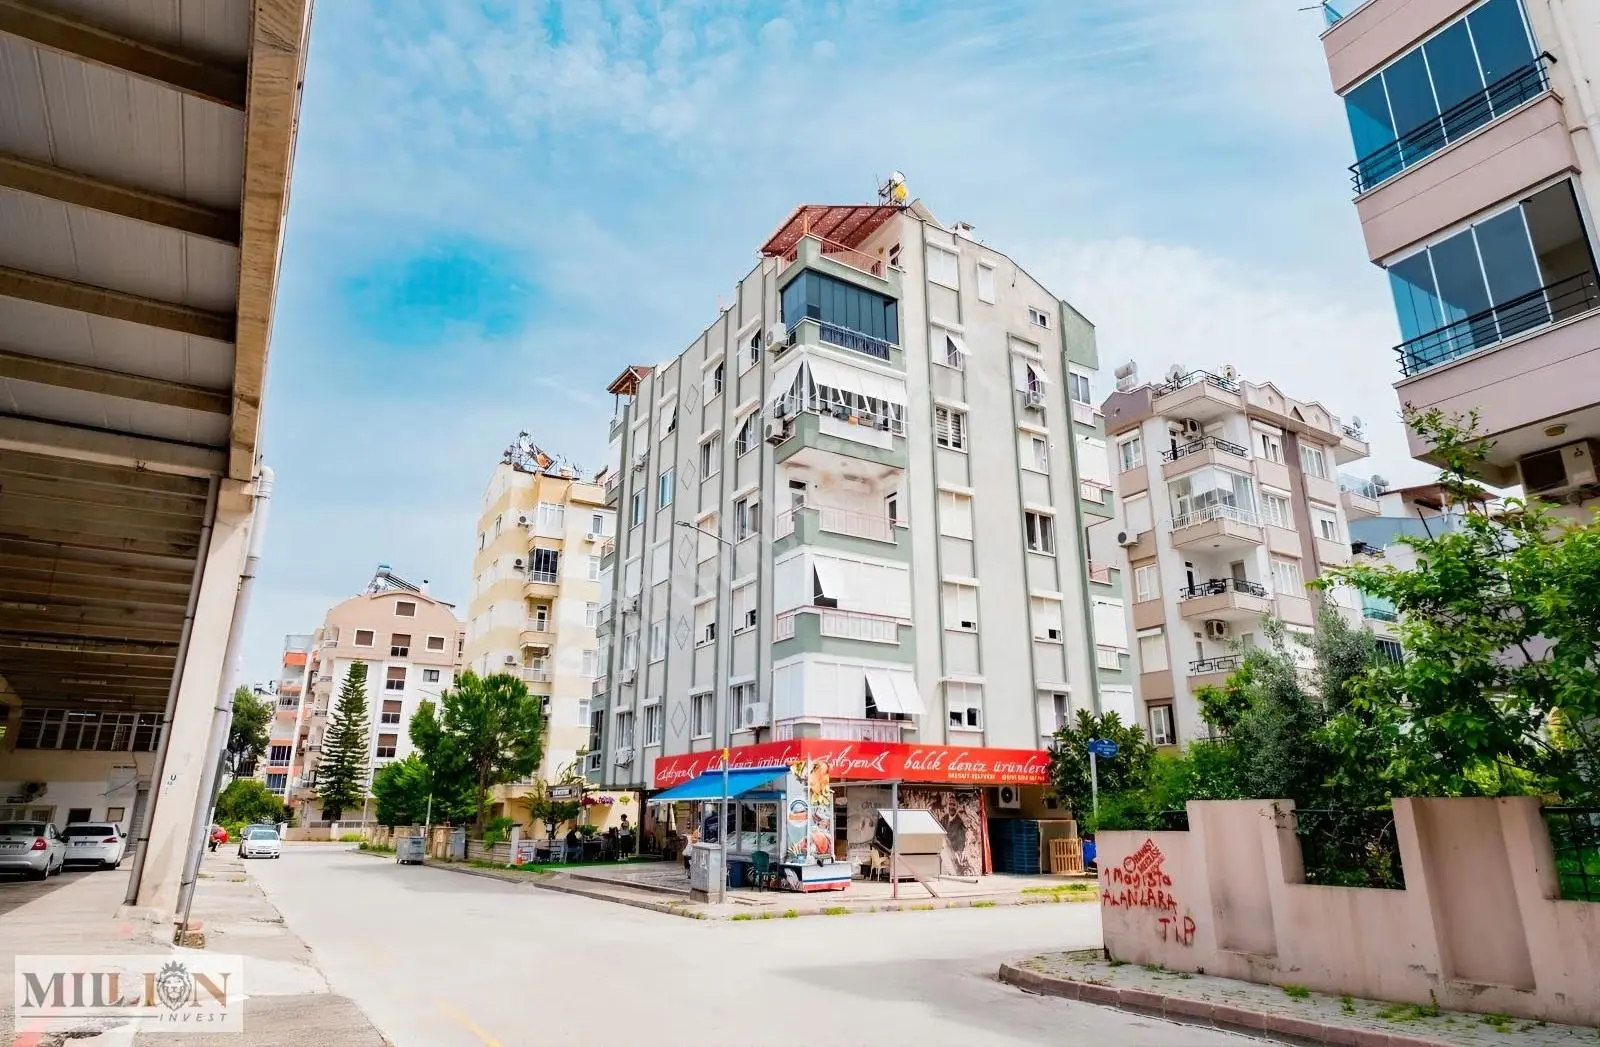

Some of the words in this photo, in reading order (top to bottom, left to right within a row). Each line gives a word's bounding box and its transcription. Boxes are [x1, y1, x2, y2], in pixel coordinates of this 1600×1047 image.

[948, 752, 987, 771] deniz
[993, 755, 1047, 774] ürünleri
[1102, 888, 1178, 915] ALANLARA
